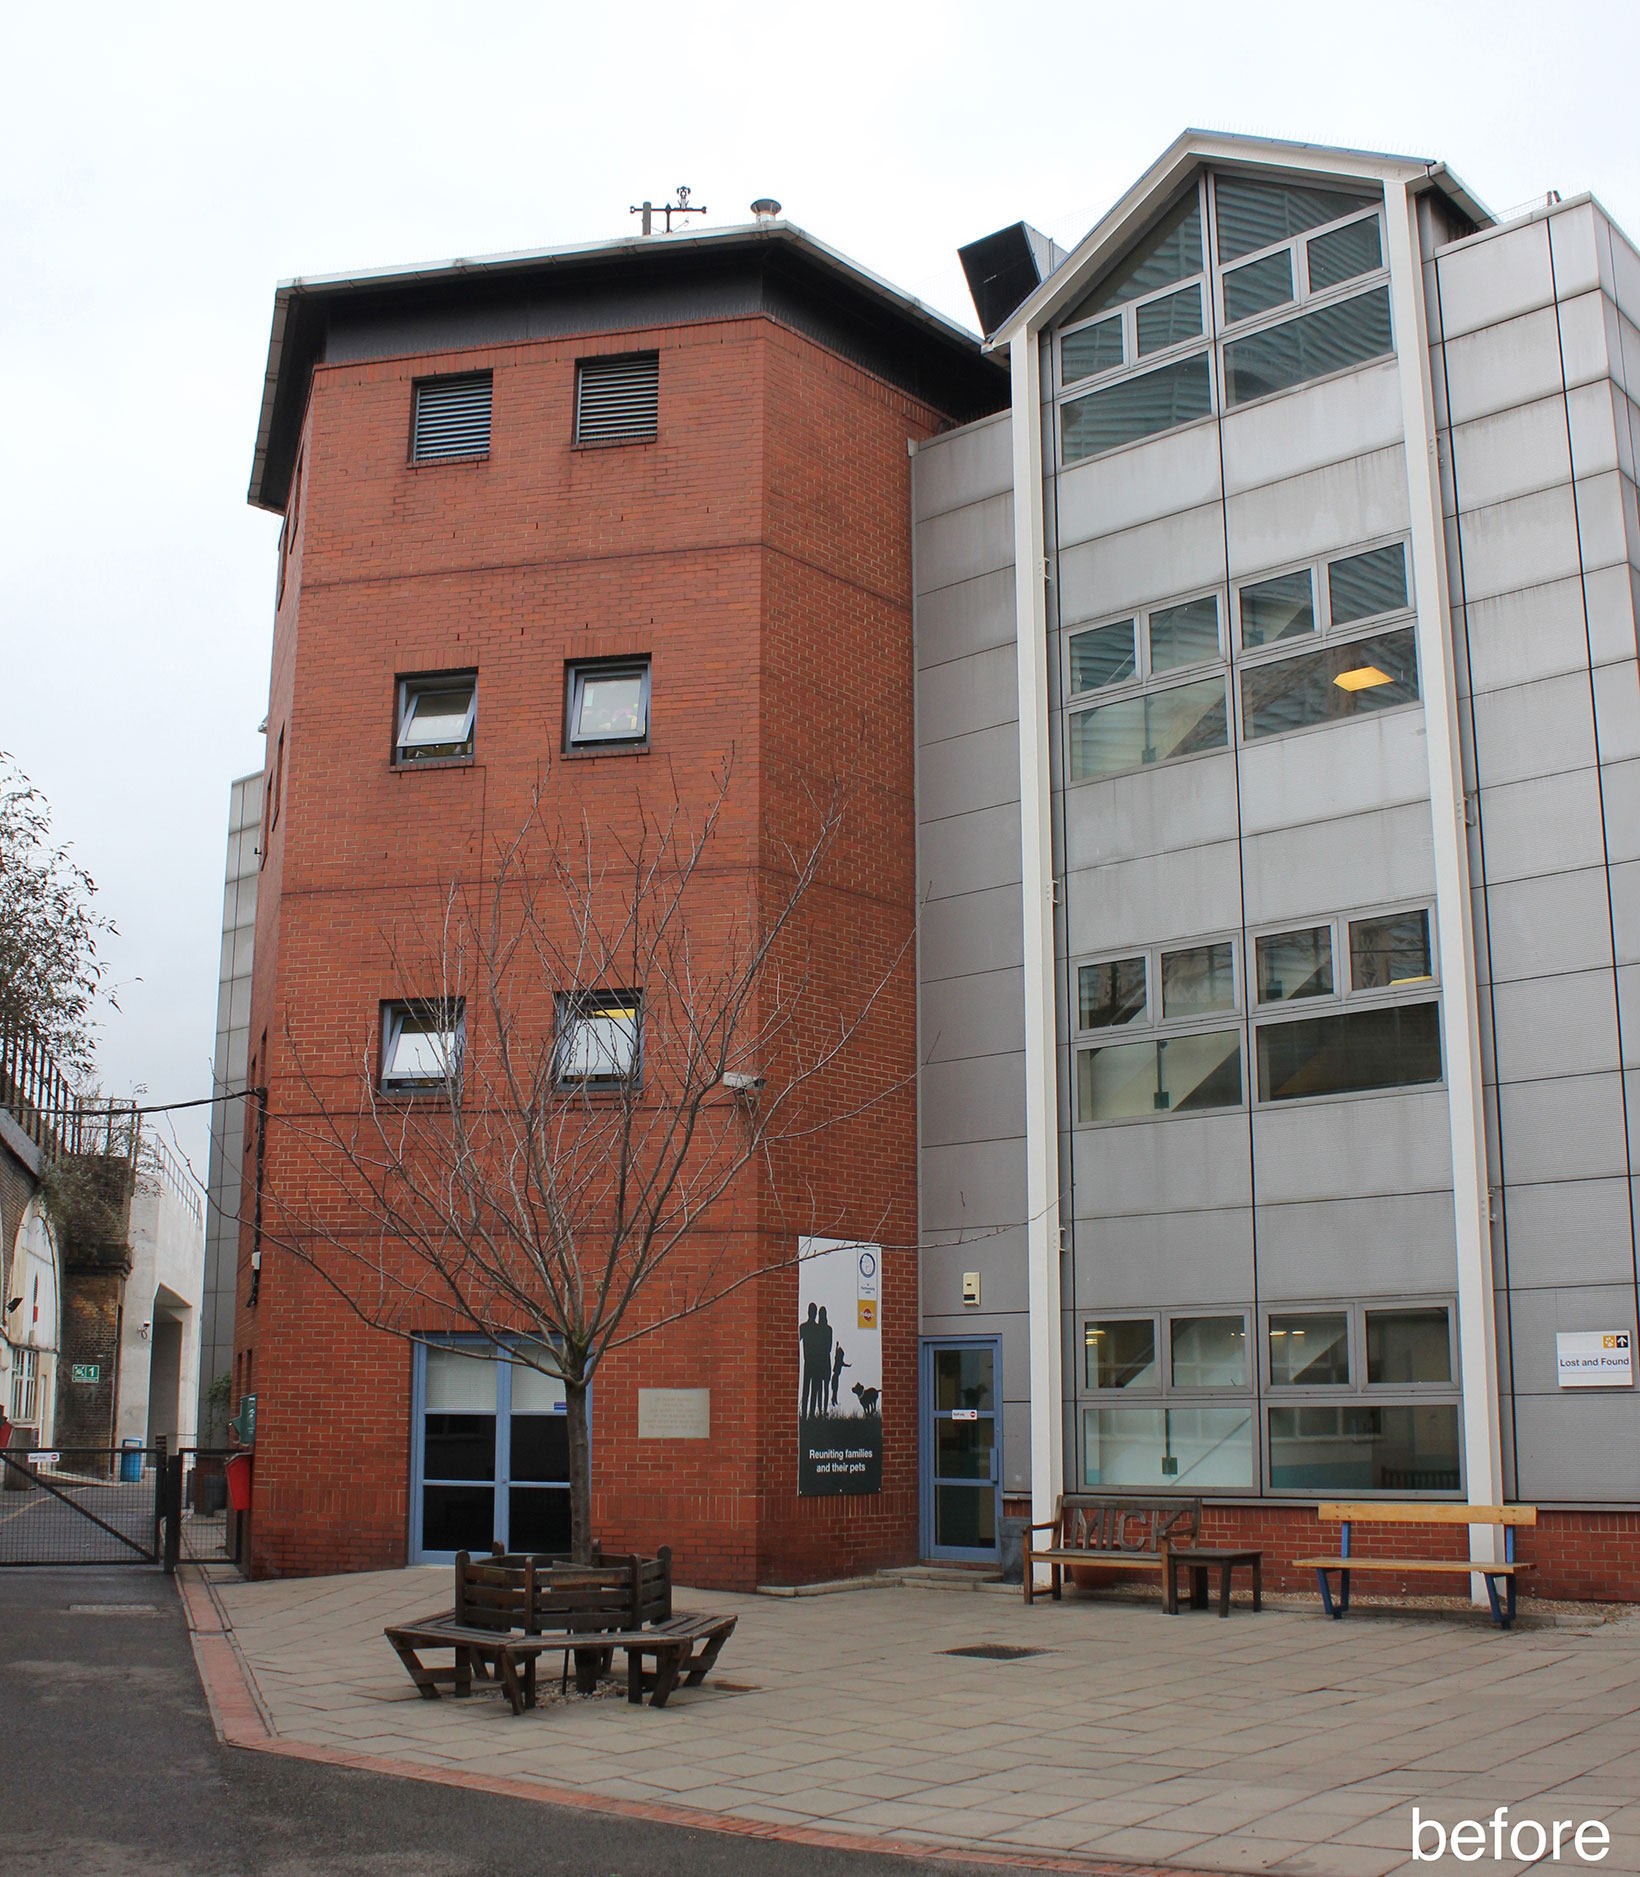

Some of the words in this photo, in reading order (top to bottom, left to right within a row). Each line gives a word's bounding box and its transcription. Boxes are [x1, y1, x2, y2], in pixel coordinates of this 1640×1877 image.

[1560, 1359, 1580, 1367] Lost
[1582, 1358, 1598, 1367] and
[1600, 1357, 1629, 1366] Found
[88, 1366, 95, 1377] 1
[809, 1449, 844, 1461] Reuniting
[845, 1448, 873, 1459] families
[816, 1462, 831, 1473] and
[831, 1462, 849, 1473] their
[849, 1462, 866, 1474] pets
